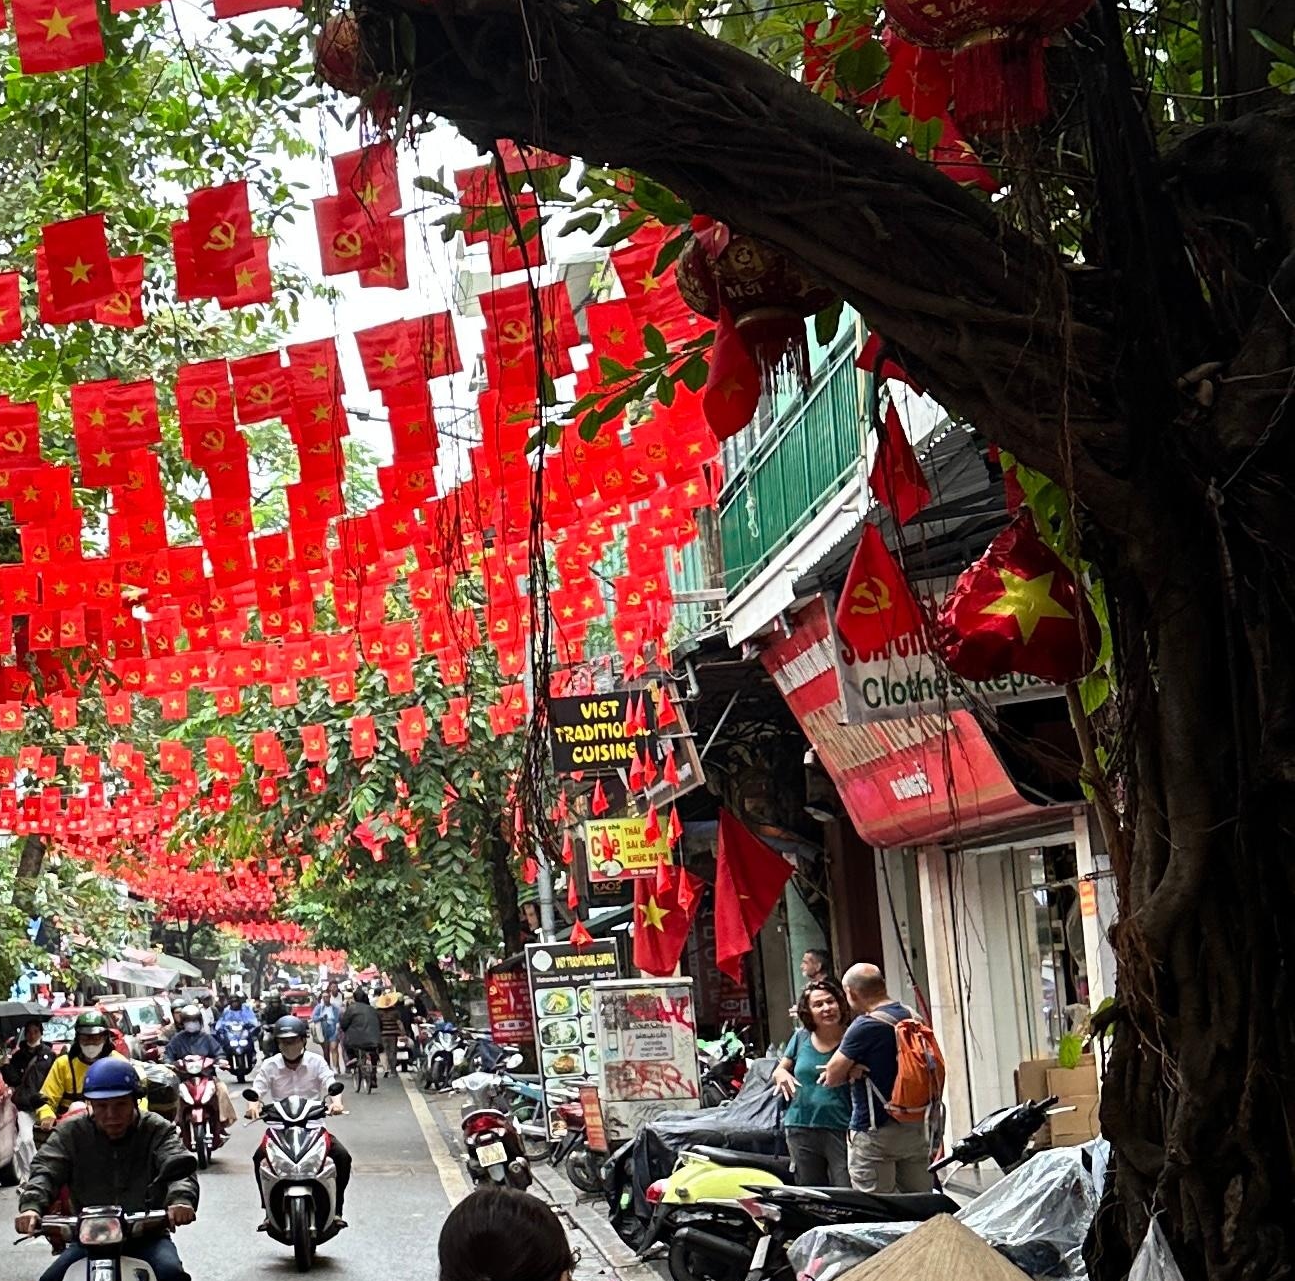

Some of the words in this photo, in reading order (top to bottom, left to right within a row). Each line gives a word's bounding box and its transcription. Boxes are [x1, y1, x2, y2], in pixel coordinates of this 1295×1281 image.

[862, 670, 965, 709] Clothes
[580, 700, 620, 719] VIET
[572, 742, 636, 763] CUISINE
[591, 833, 621, 857] Cè
